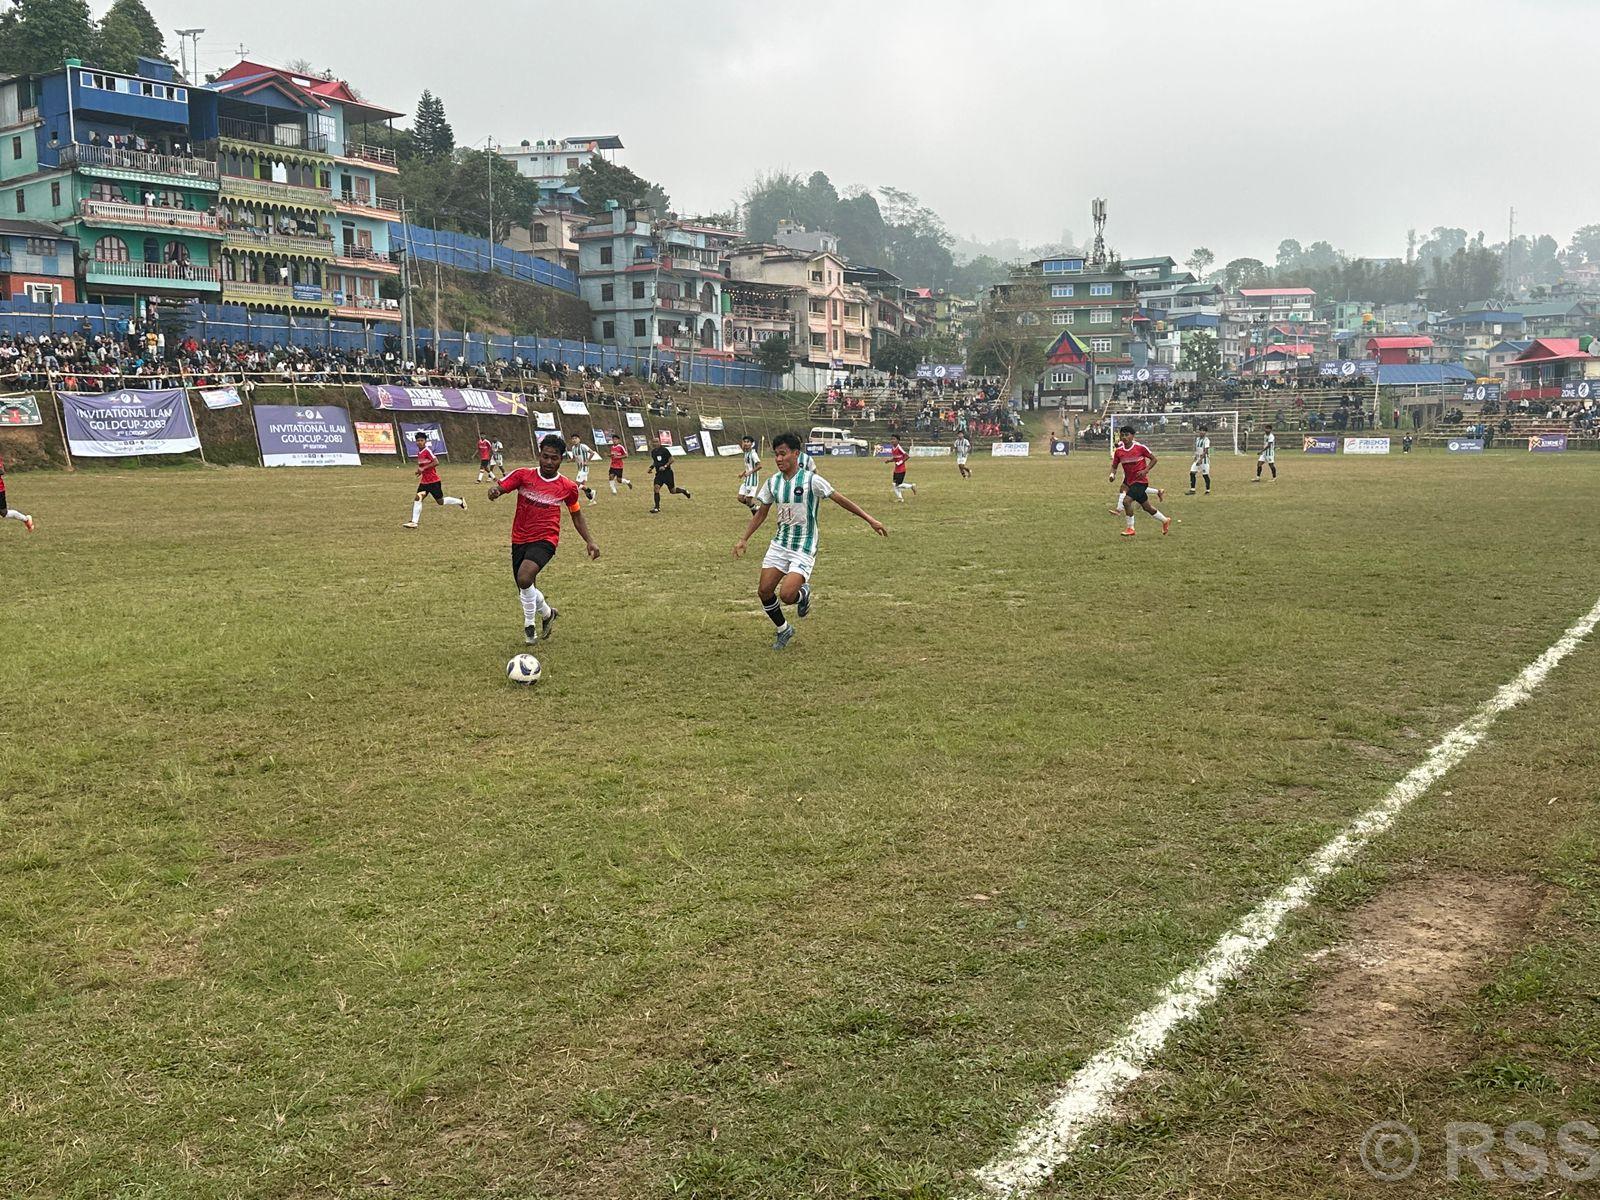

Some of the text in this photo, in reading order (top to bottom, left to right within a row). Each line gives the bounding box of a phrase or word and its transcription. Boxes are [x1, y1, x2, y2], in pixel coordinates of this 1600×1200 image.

[404, 388, 445, 401] XTREME
[1561, 389, 1575, 397] ZONE
[76, 407, 173, 418] INVITATIONAL ILAM
[89, 419, 166, 430] GOLDCUP-2083
[269, 424, 329, 433] INVITATIONAL
[329, 425, 346, 433] ILAM
[281, 434, 343, 443] GOLDCUP-2083
